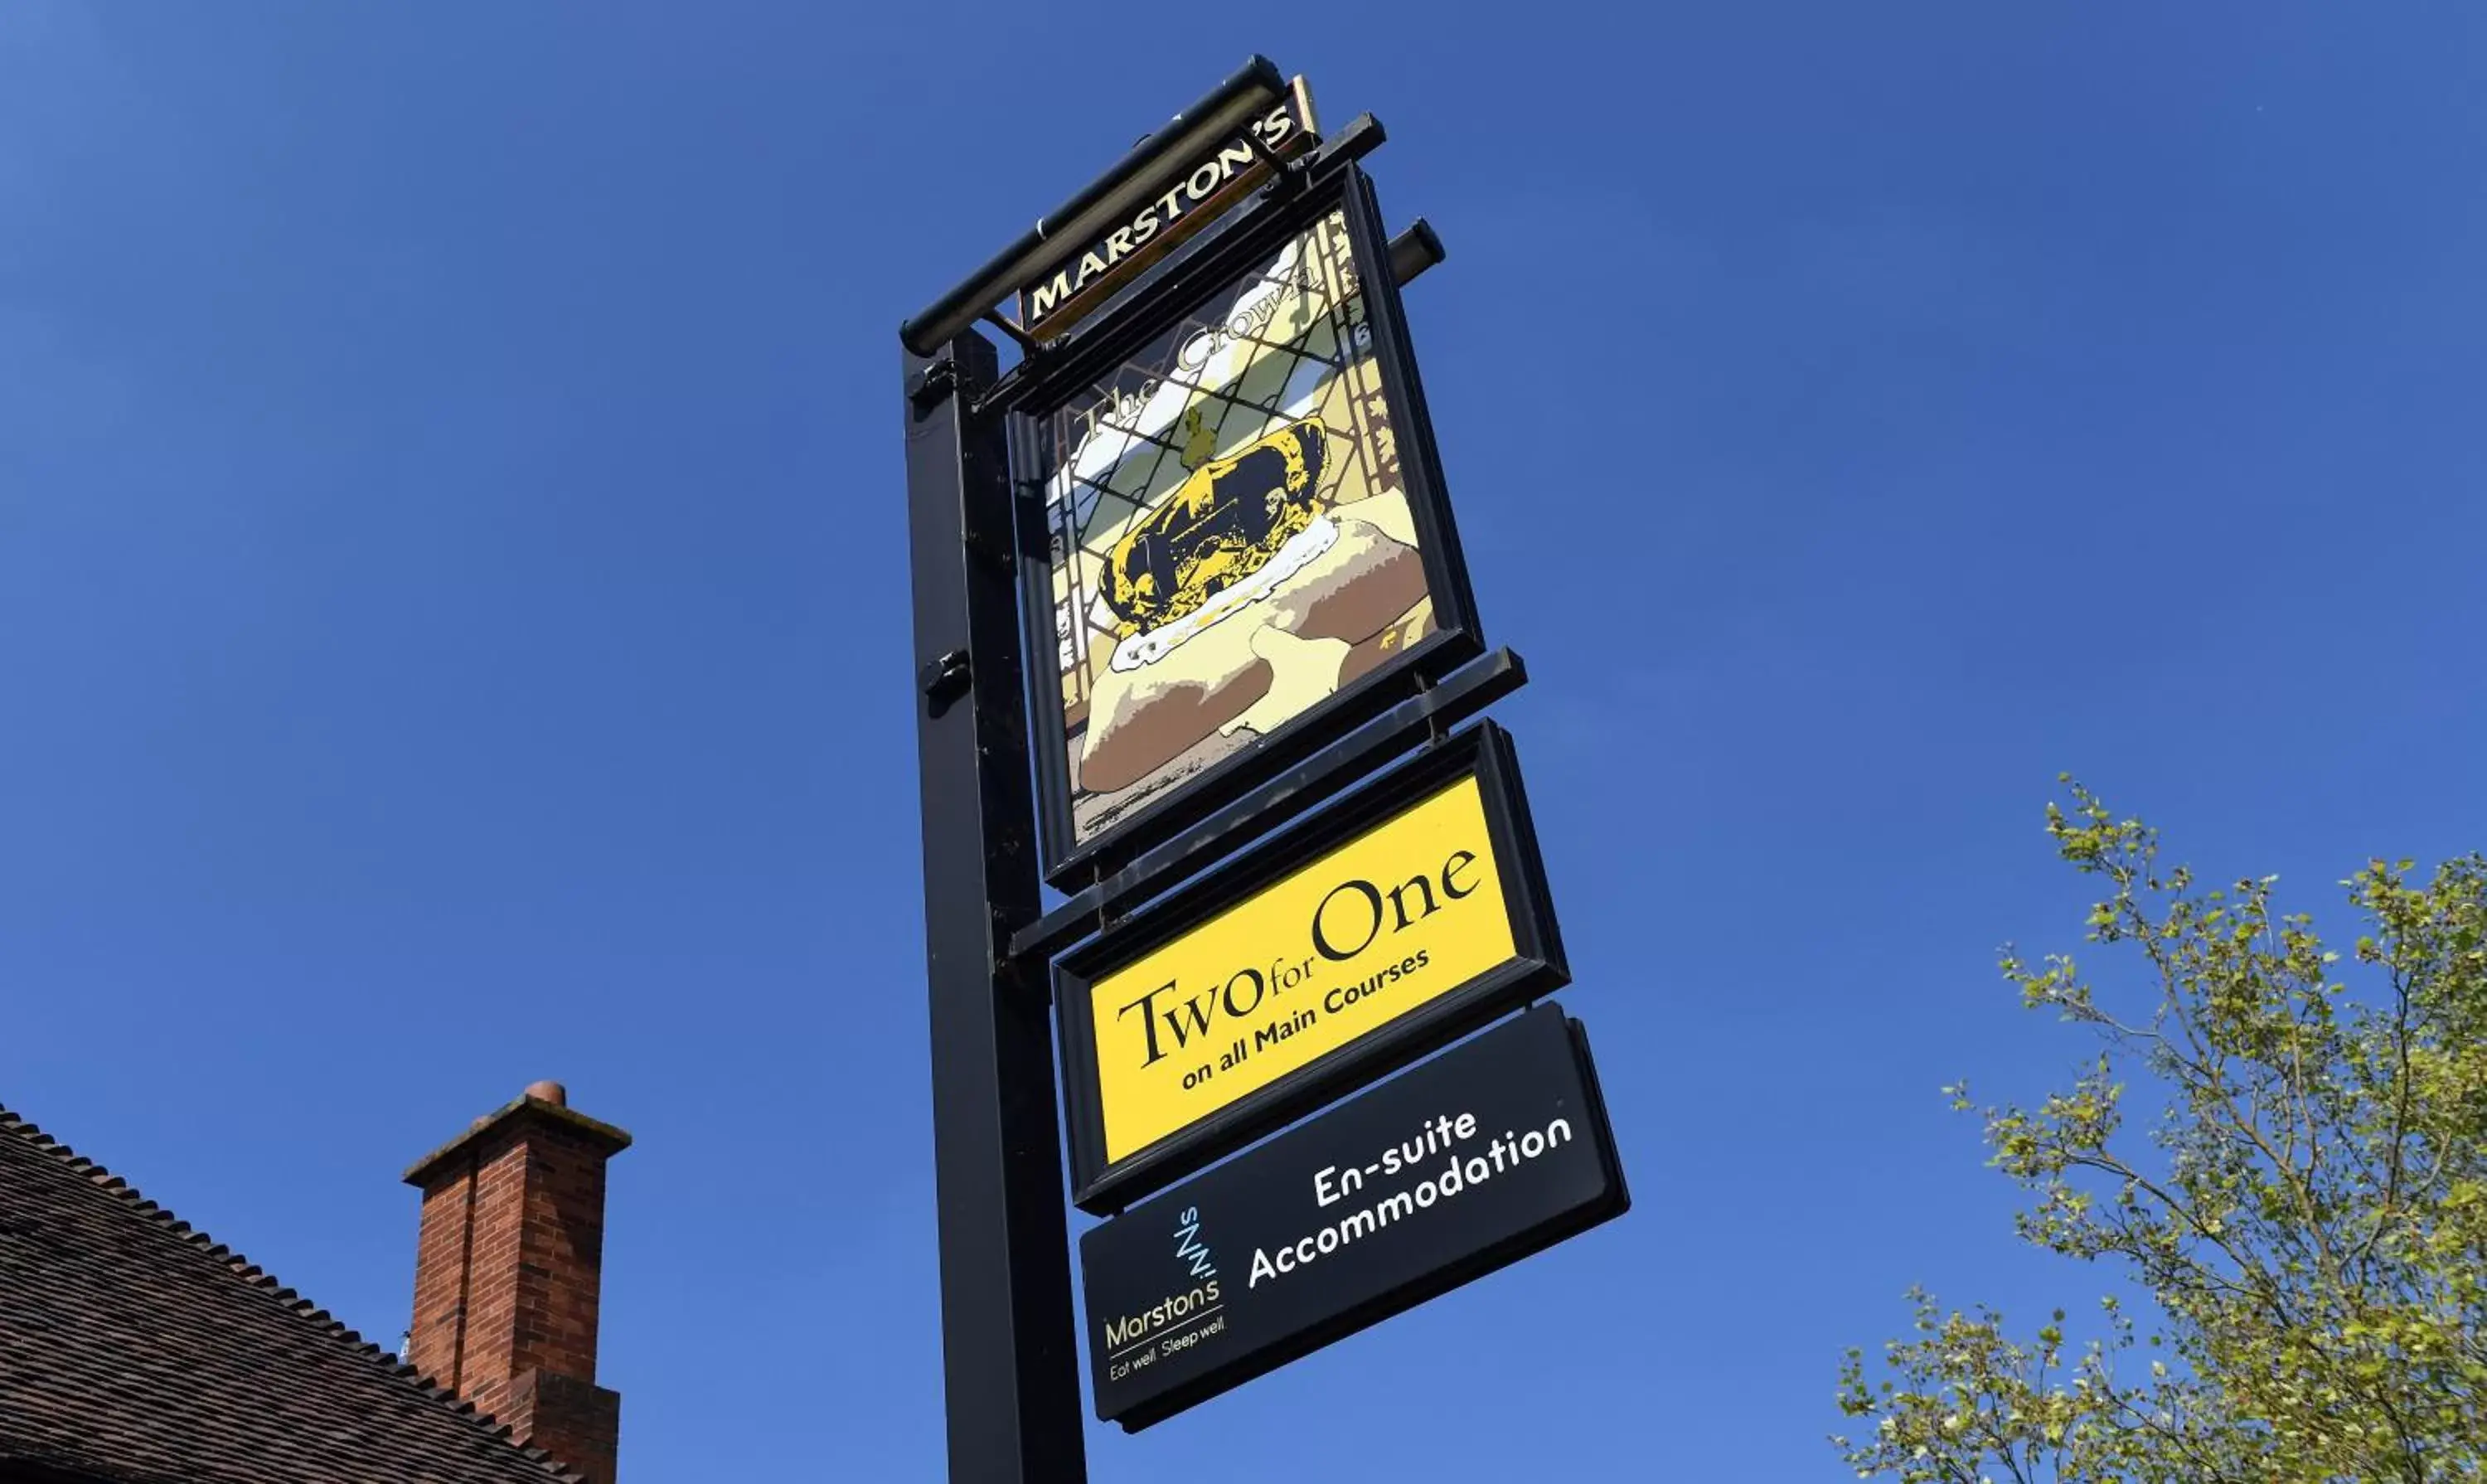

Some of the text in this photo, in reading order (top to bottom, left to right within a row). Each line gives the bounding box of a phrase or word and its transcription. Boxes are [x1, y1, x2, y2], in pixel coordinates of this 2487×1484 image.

[1032, 105, 1295, 321] MARSTON'S
[1074, 265, 1322, 441] The Crown
[1117, 849, 1481, 1069] Two for One
[1181, 949, 1430, 1090] on all Main Courses
[1248, 1118, 1573, 1290] Accommodation
[1314, 1112, 1477, 1208] En-suite
[1109, 1361, 1129, 1381] Eat
[1161, 1330, 1199, 1357] Sleep
